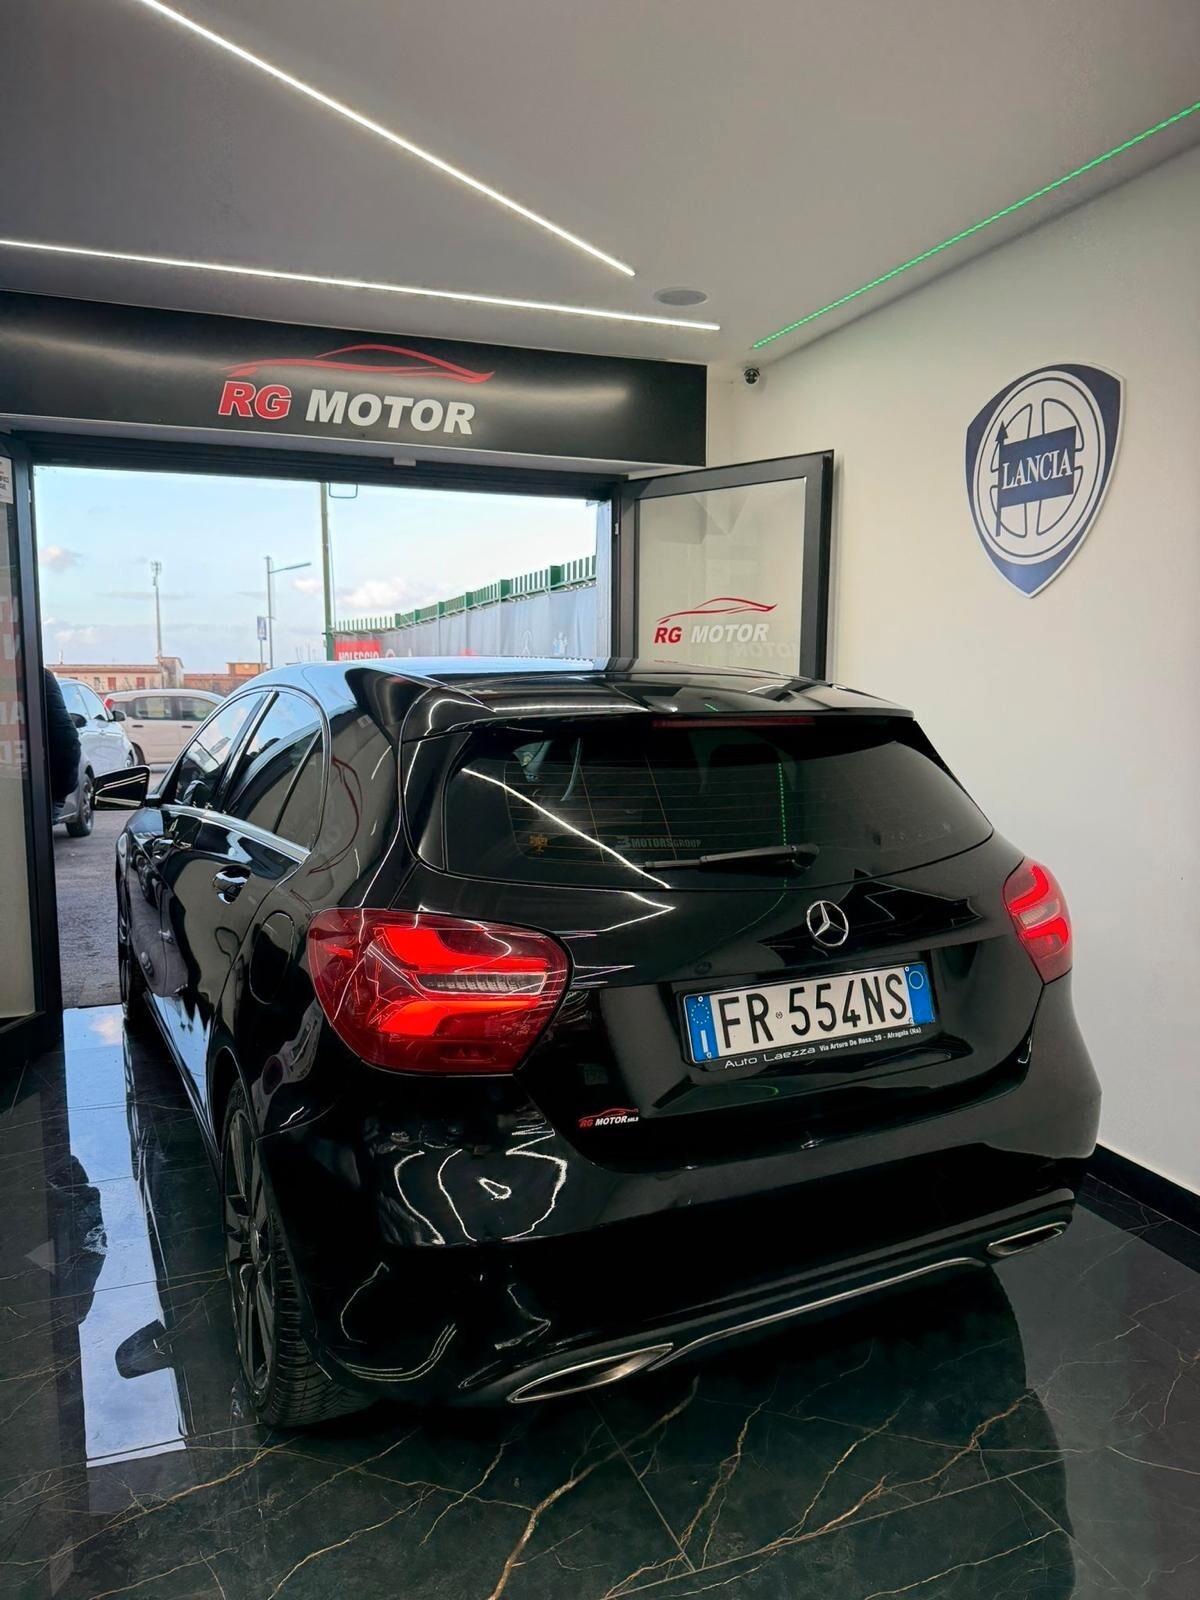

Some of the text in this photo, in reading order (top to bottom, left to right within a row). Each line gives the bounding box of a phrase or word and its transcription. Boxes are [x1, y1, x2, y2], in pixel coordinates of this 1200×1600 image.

[218, 380, 475, 435] RG MOTOR
[1001, 447, 1073, 490] LANCIA
[654, 623, 769, 644] RG MOTOR
[718, 973, 907, 1049] FR 554NS
[724, 1057, 758, 1069] Auto
[763, 1046, 816, 1063] Laezza
[819, 1044, 829, 1052] Via
[595, 1115, 628, 1127] MOTOR
